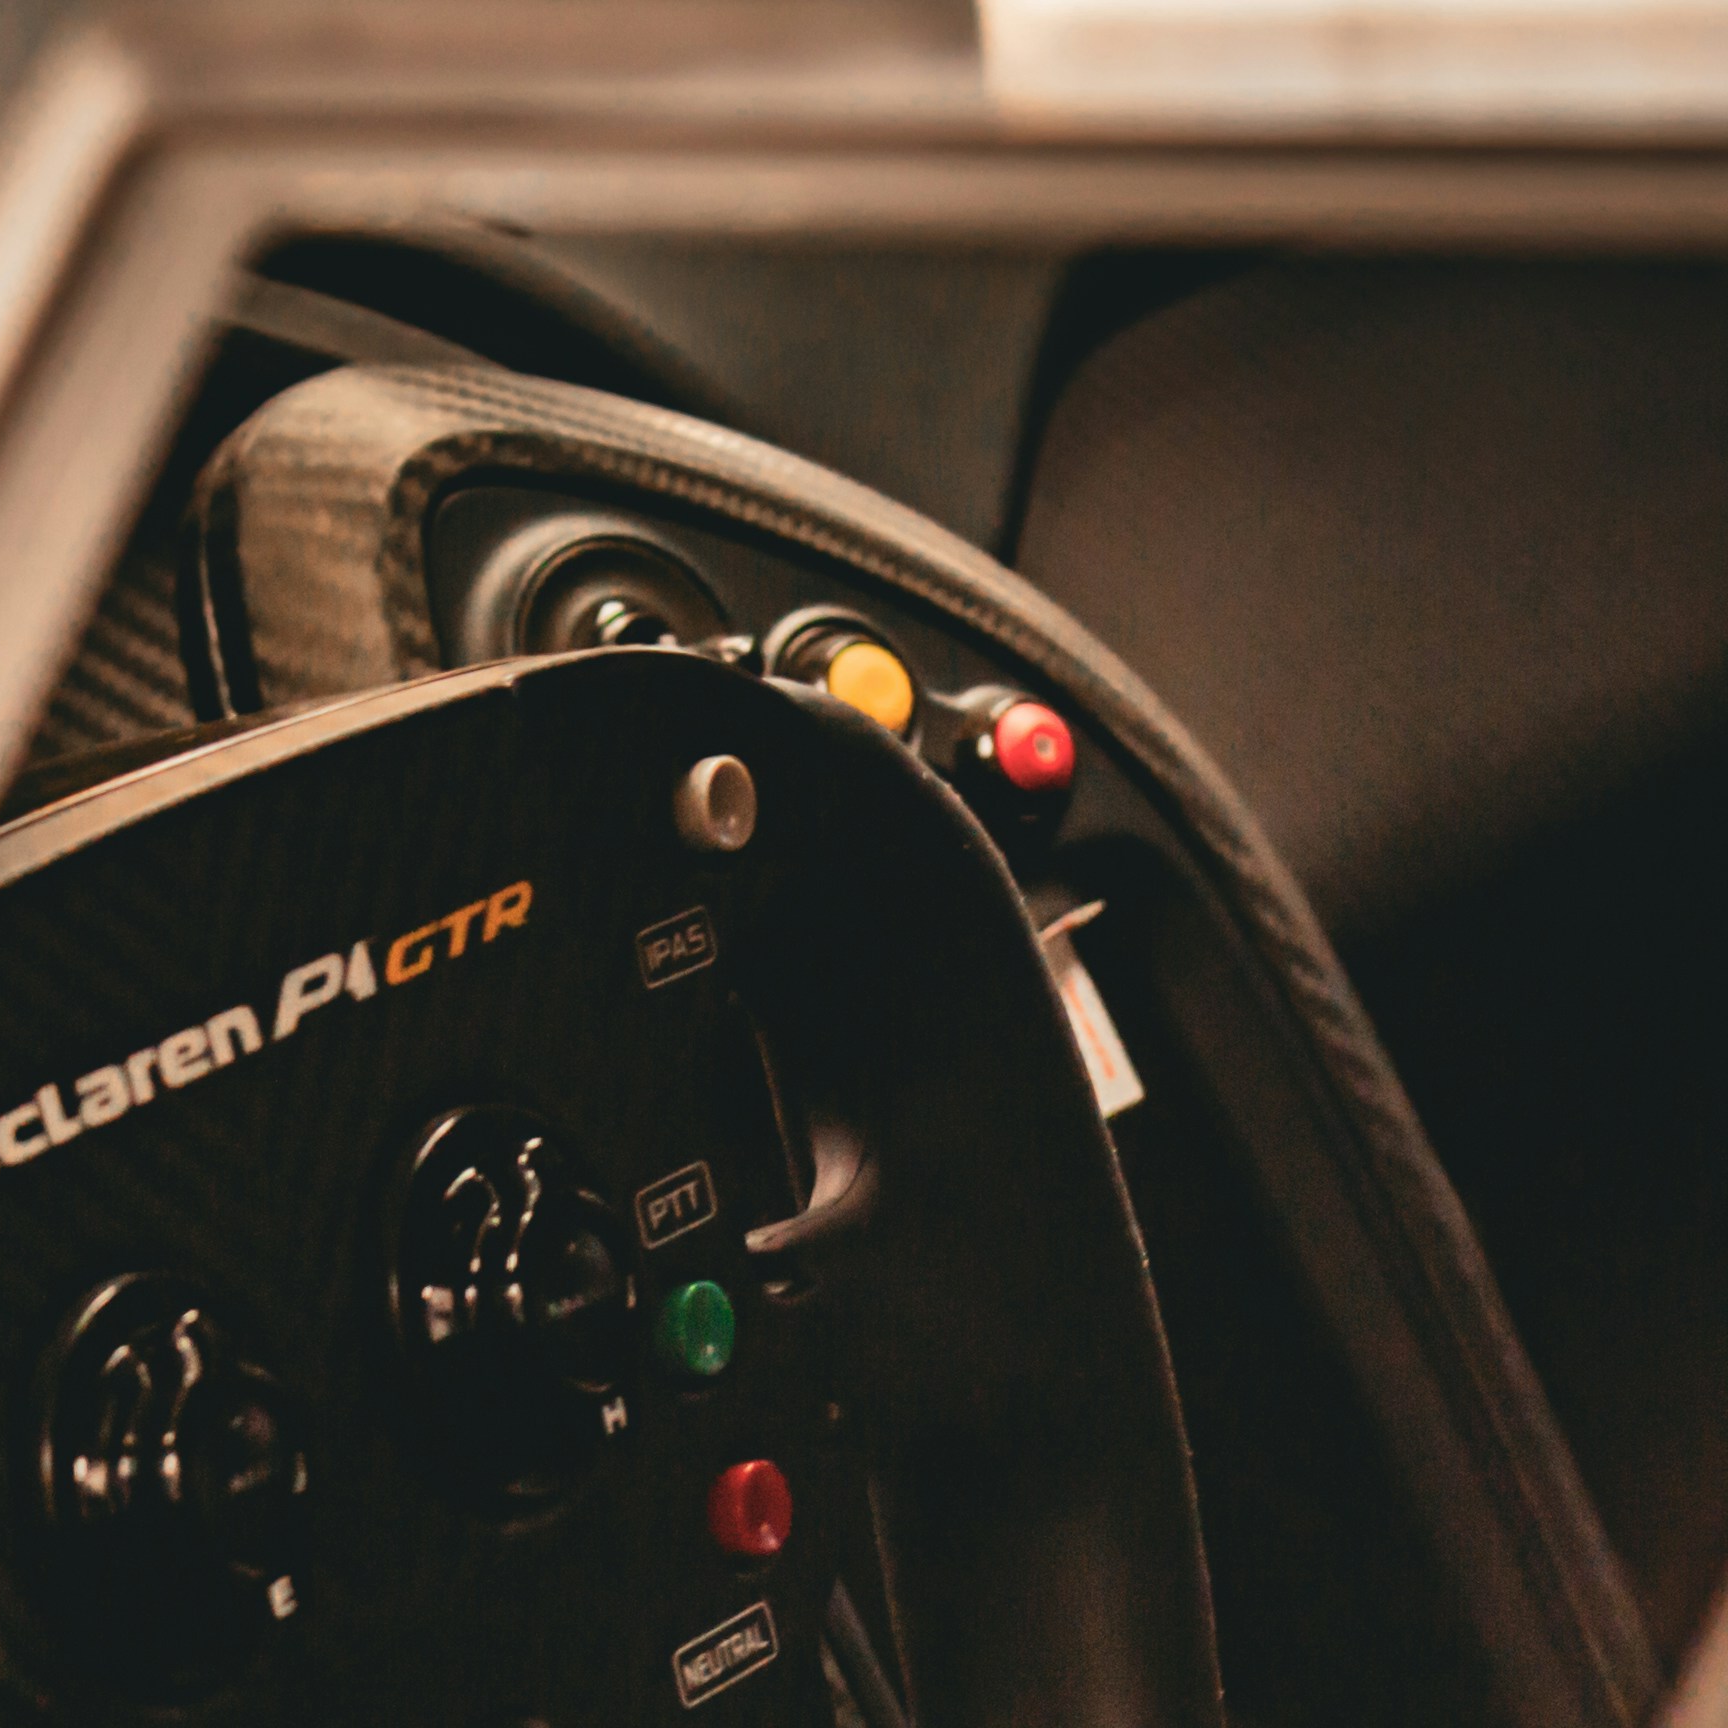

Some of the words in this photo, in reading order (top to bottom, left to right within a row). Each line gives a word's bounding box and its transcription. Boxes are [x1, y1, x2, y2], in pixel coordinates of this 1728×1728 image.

[383, 880, 534, 986] GTR
[644, 924, 708, 970] IPAS
[647, 1180, 700, 1231] PTT
[601, 1396, 629, 1435] H
[683, 1622, 770, 1690] NEUTRAL
